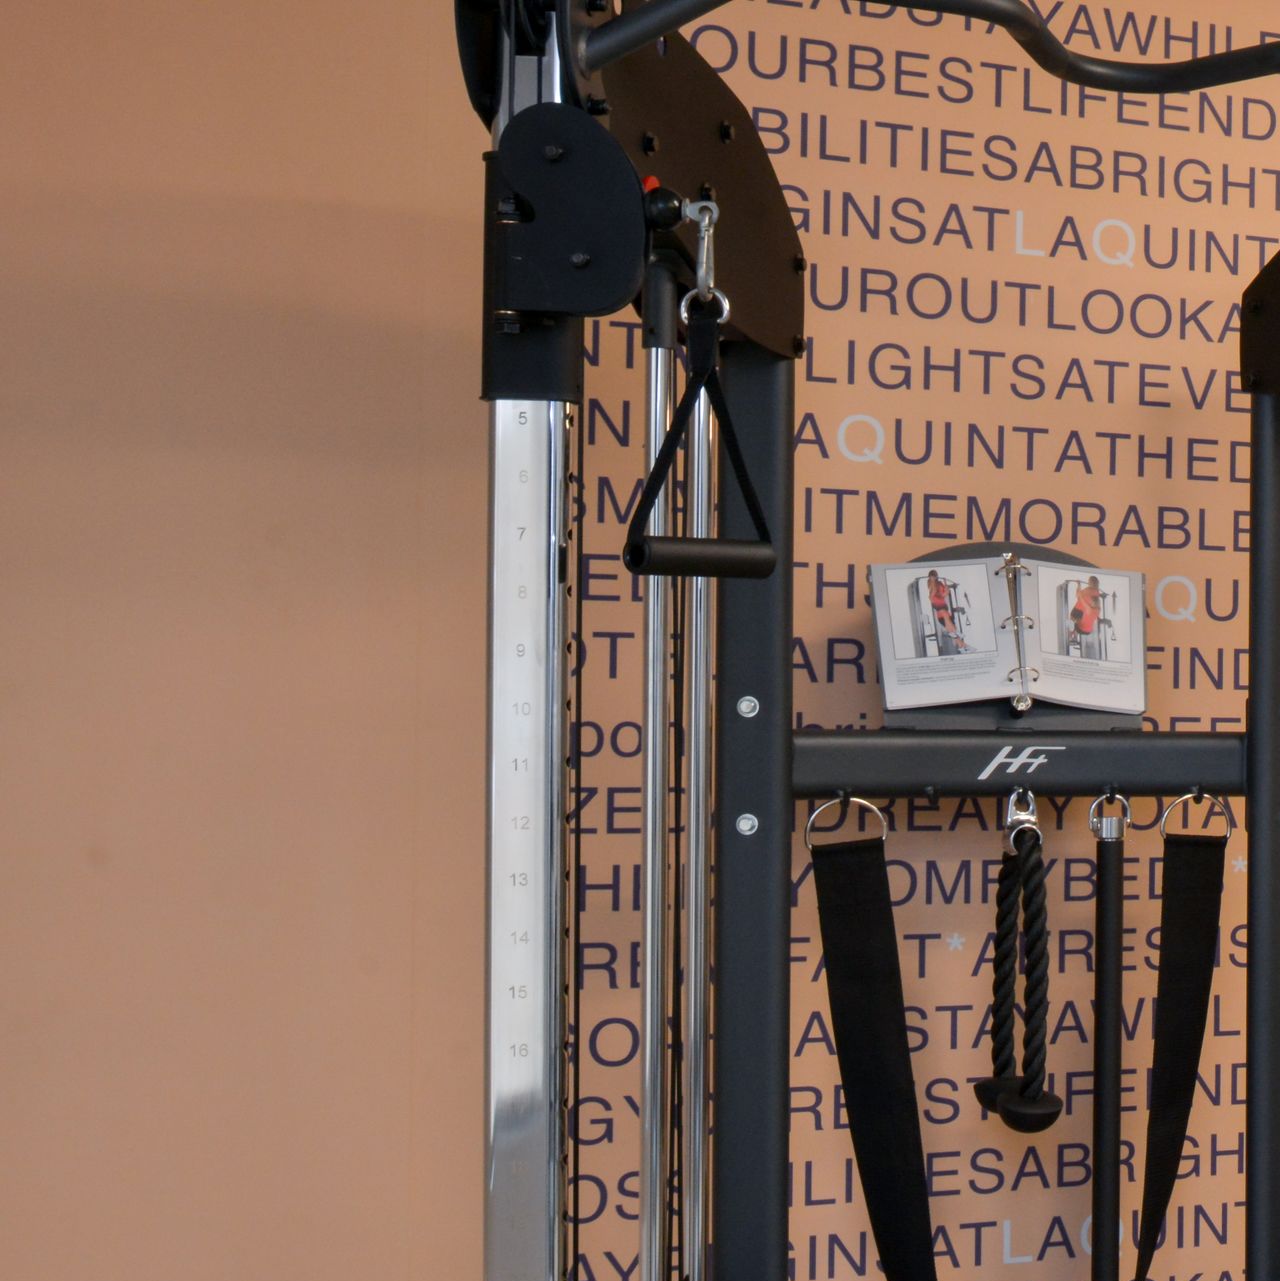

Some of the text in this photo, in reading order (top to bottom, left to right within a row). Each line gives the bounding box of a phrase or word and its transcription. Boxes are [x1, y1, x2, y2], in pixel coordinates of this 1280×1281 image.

[511, 702, 531, 716] 10
[511, 816, 530, 831] 12
[509, 873, 529, 887] 13
[510, 931, 530, 945] 14
[508, 986, 528, 1000] 15
[509, 1043, 529, 1058] 16
